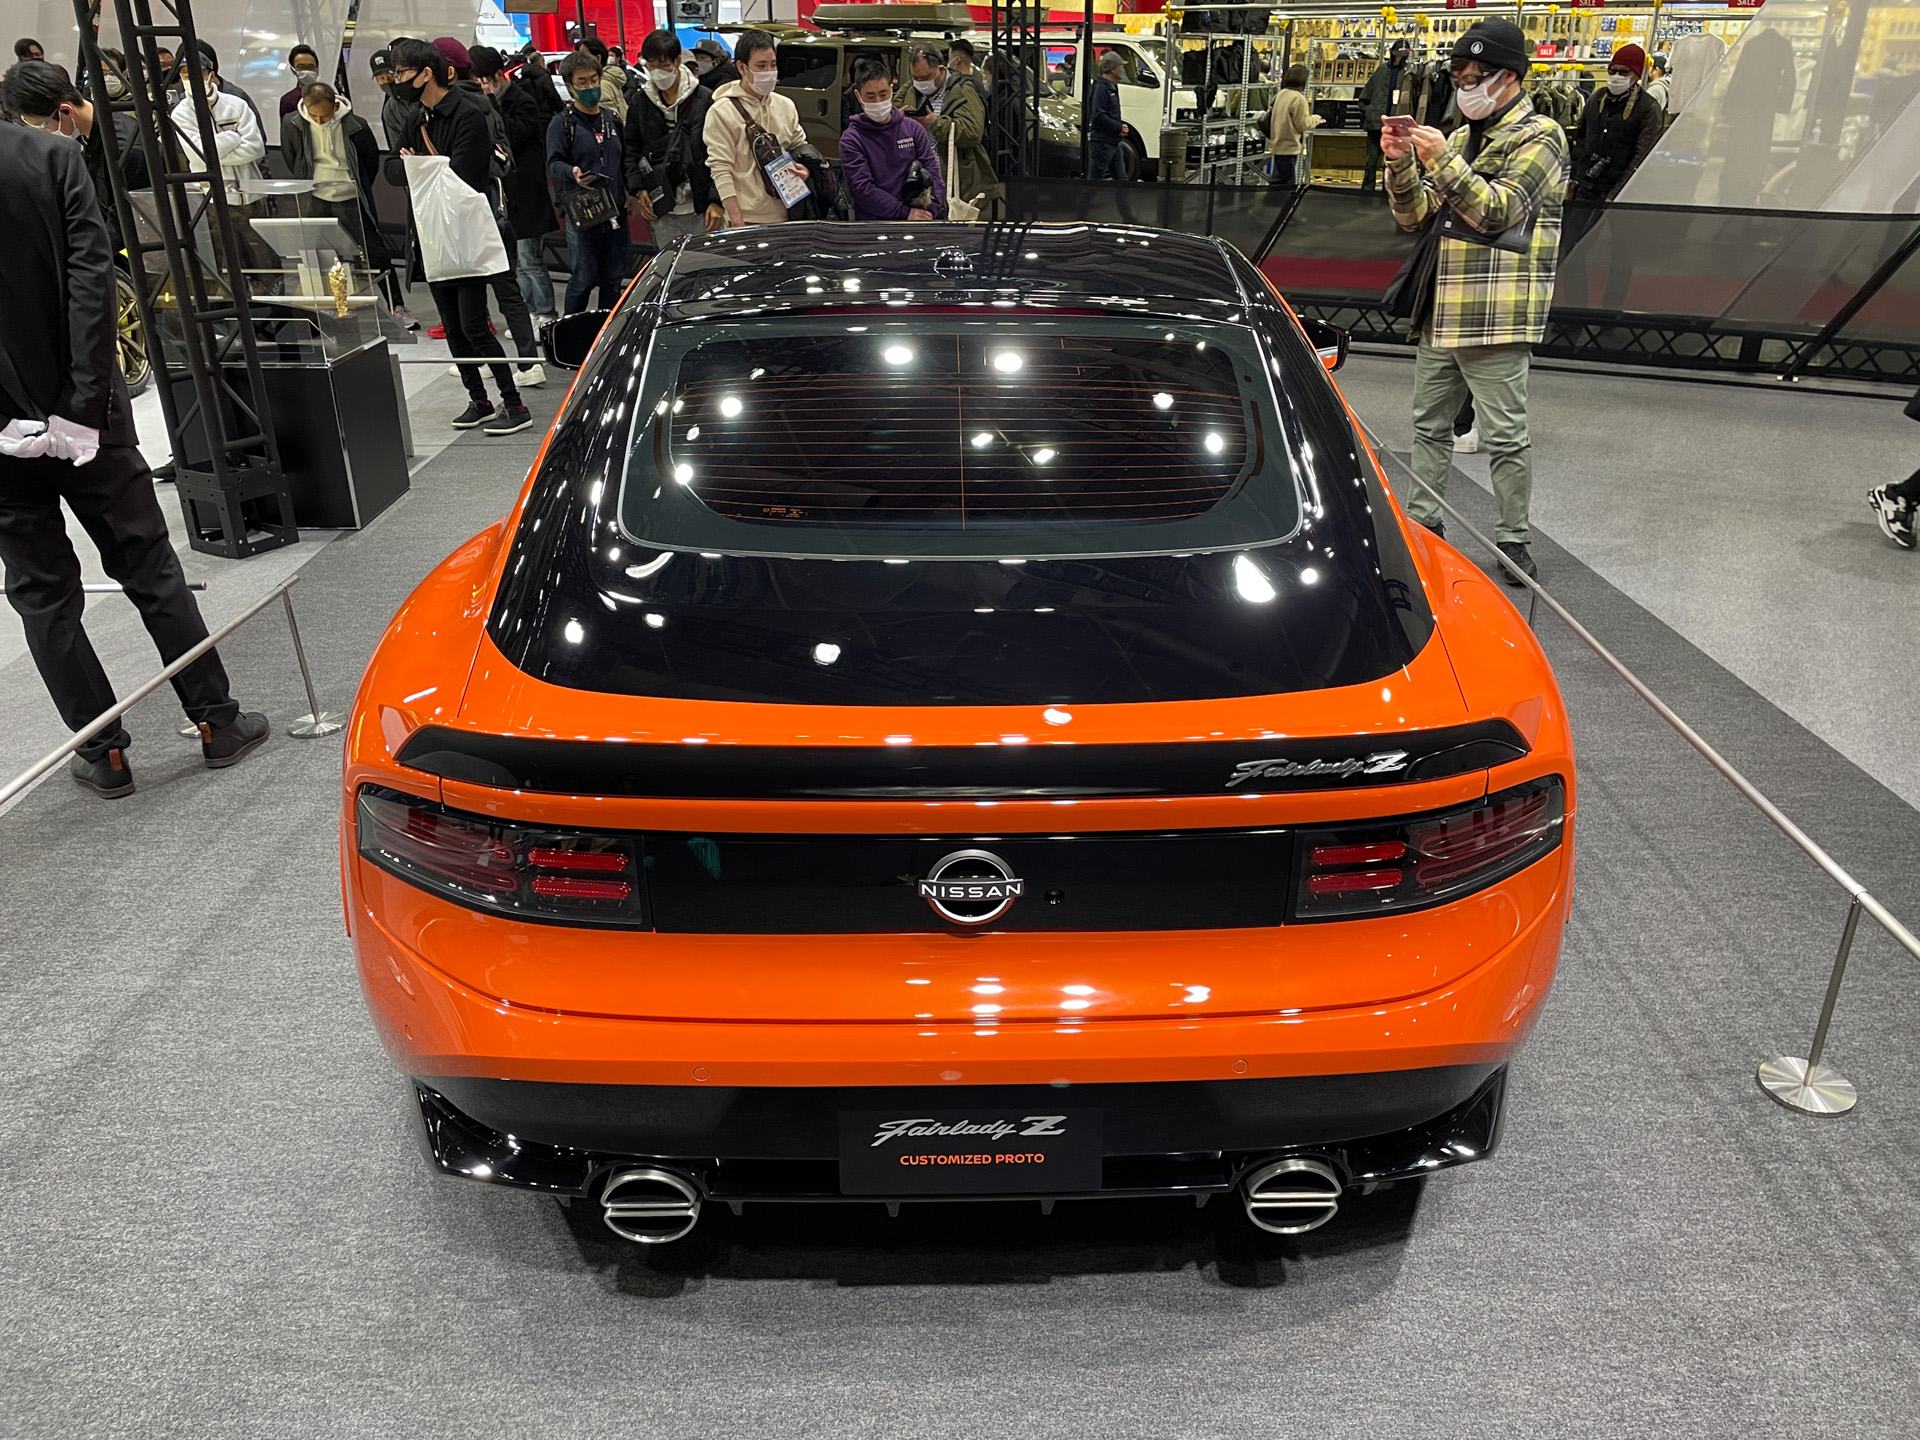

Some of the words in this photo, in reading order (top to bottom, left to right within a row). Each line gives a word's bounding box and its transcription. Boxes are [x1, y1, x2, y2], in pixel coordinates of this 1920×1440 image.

[1540, 48, 1552, 56] SALE
[1225, 758, 1365, 787] Fairlady
[1364, 749, 1409, 774] Z
[921, 883, 1021, 898] NISSAN
[871, 1119, 1017, 1147] Fairlady
[1018, 1115, 1067, 1136] Z
[900, 1154, 992, 1166] CUSTOMIZED
[995, 1153, 1045, 1164] PROTO
